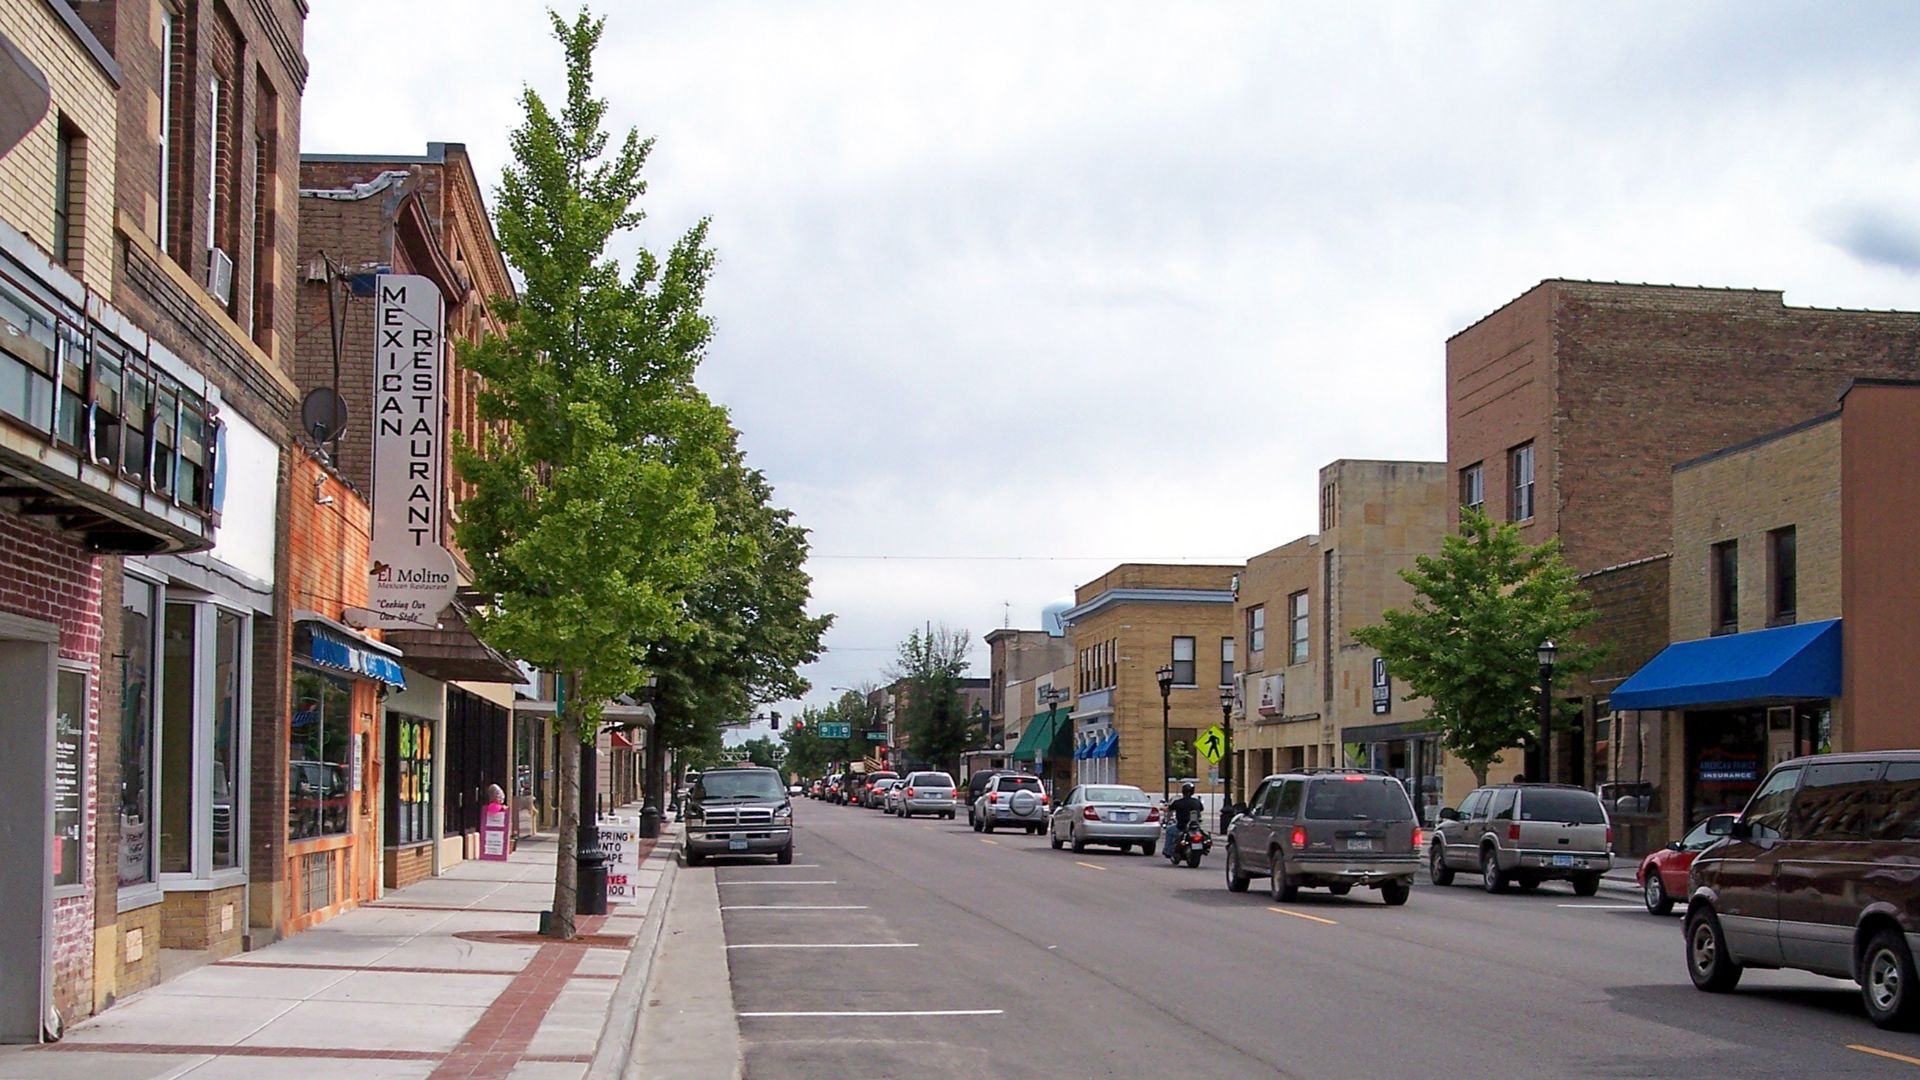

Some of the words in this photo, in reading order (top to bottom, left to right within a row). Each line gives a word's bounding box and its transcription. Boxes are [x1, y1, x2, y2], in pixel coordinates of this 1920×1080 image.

[380, 286, 406, 436] MEXICAN
[408, 329, 433, 546] RESTAURANT
[378, 567, 392, 582] El
[397, 567, 450, 583] Molino
[410, 582, 448, 590] Restaurant
[606, 853, 623, 862] APE
[608, 875, 627, 884] VES
